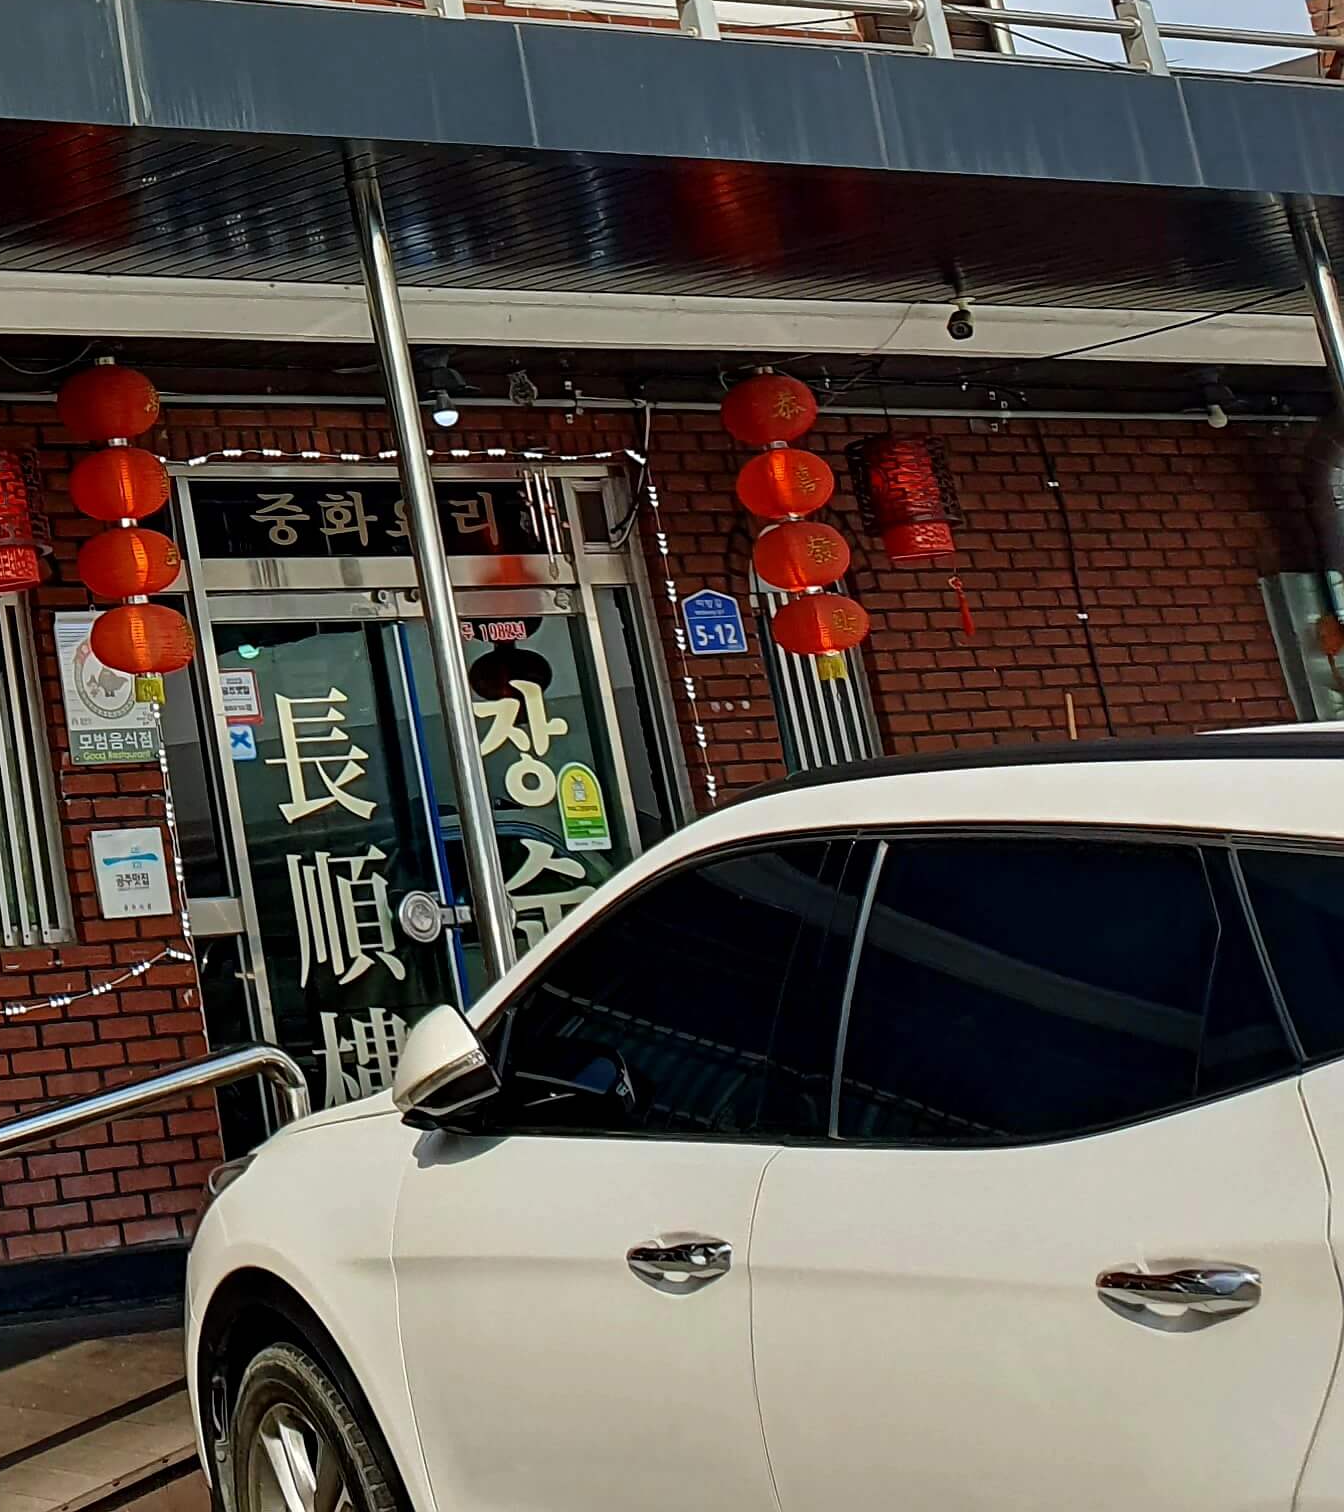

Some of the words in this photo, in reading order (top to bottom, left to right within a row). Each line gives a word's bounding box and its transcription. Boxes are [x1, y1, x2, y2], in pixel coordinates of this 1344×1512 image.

[695, 623, 739, 646] 5-12
[79, 730, 154, 751] 모범음식점
[83, 750, 107, 761] Good
